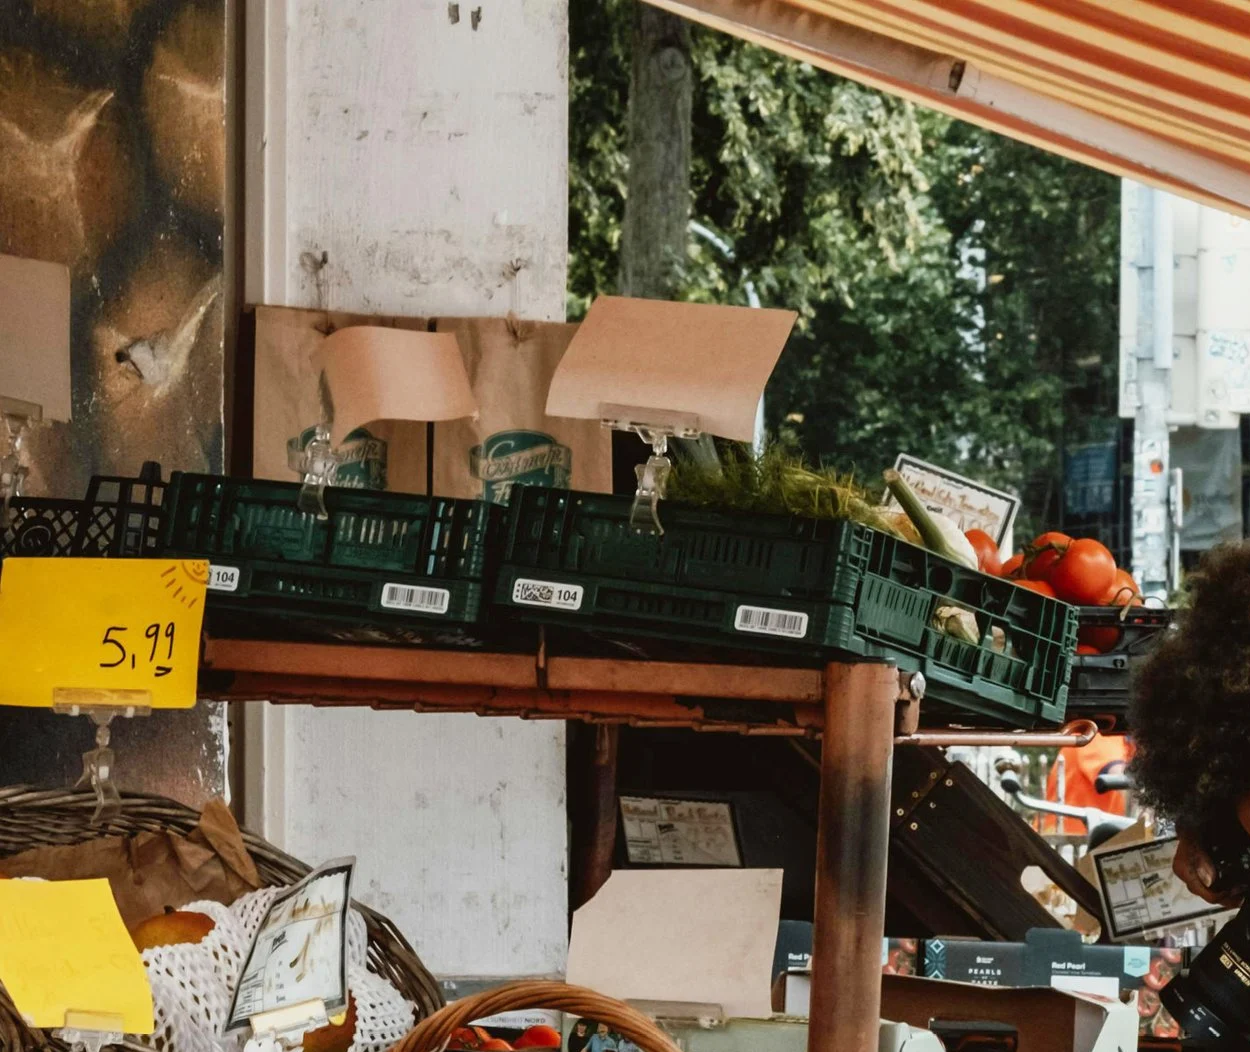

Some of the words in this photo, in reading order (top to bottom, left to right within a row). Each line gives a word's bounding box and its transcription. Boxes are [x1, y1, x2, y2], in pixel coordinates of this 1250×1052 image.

[215, 570, 235, 583] 104
[557, 589, 578, 602] 104
[100, 622, 175, 670] 5,99
[968, 968, 1002, 976] PEARLS
[1052, 961, 1066, 969] Red
[1067, 961, 1086, 970] Pearl
